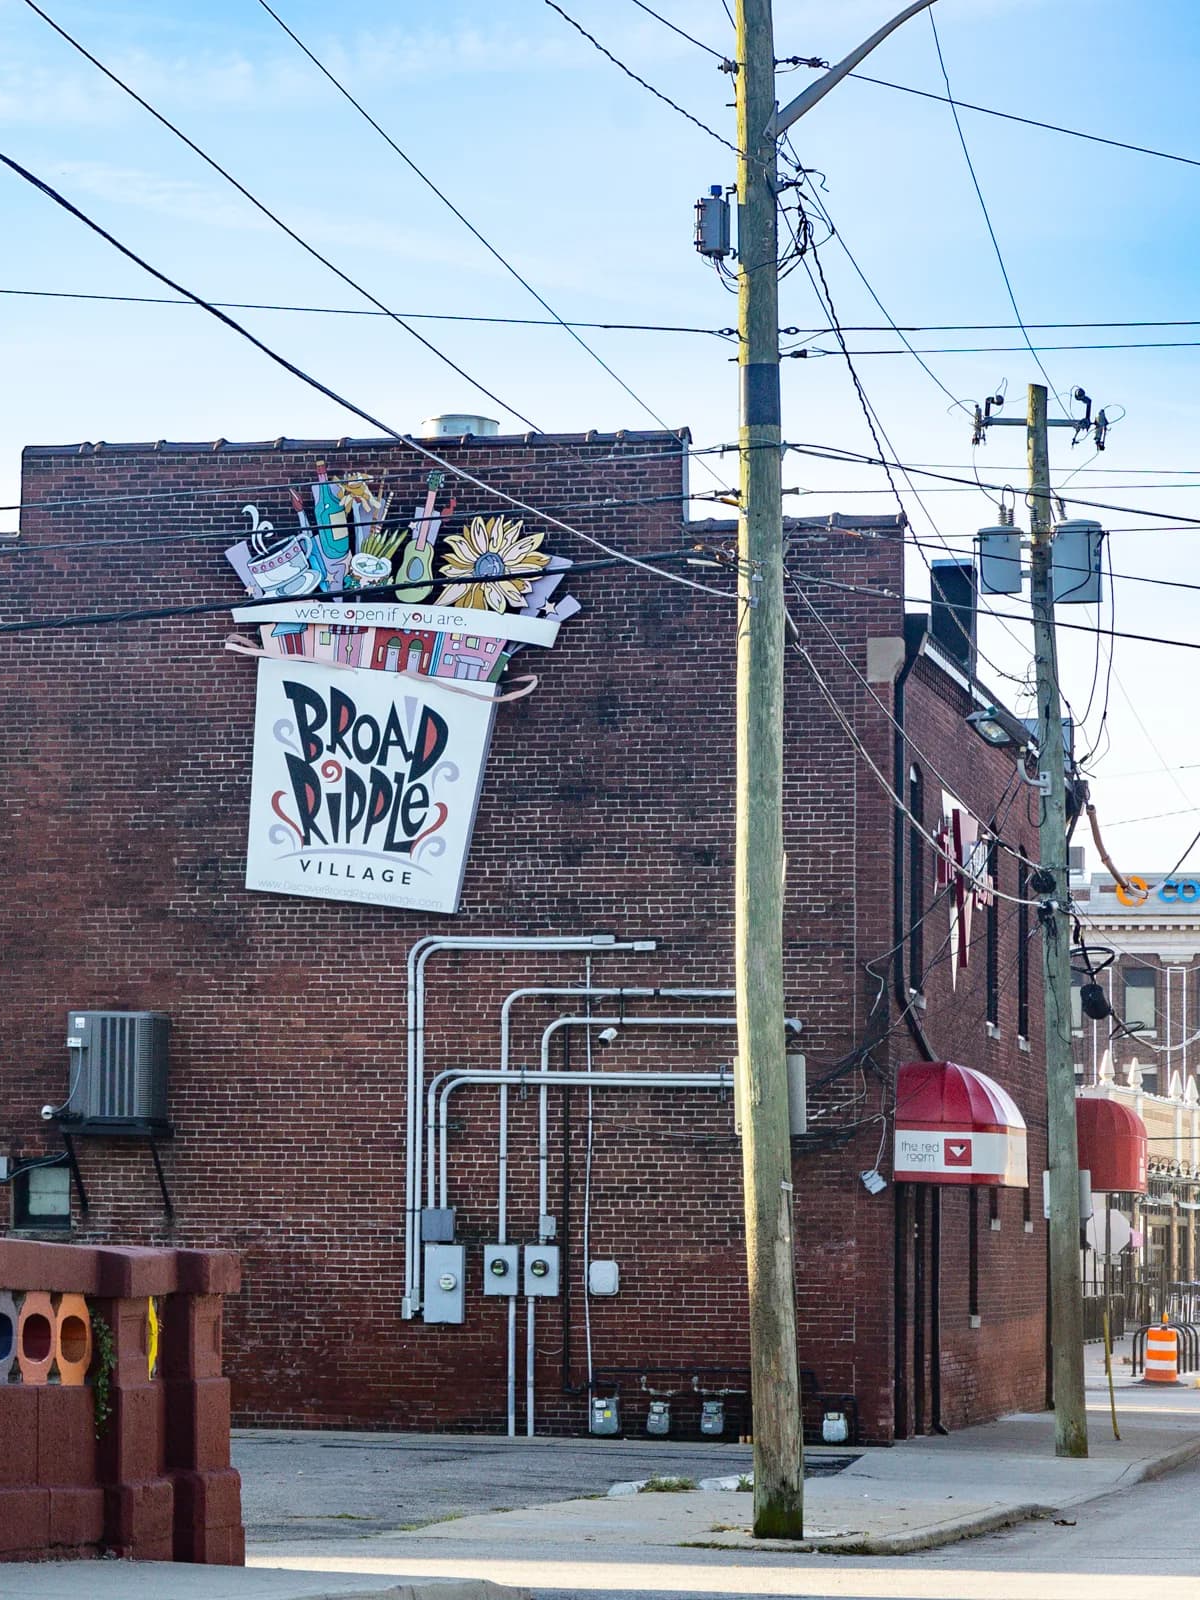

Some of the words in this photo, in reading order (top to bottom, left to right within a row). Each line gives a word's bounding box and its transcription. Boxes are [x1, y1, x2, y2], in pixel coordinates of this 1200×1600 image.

[295, 604, 340, 620] we're
[344, 608, 384, 626] open
[387, 607, 399, 623] if
[403, 611, 433, 627] you
[437, 613, 468, 627] are.
[282, 680, 449, 784] BROAD
[300, 859, 412, 885] VILLAGE
[901, 1140, 918, 1152] the
[921, 1141, 940, 1153] red
[906, 1152, 935, 1163] room
